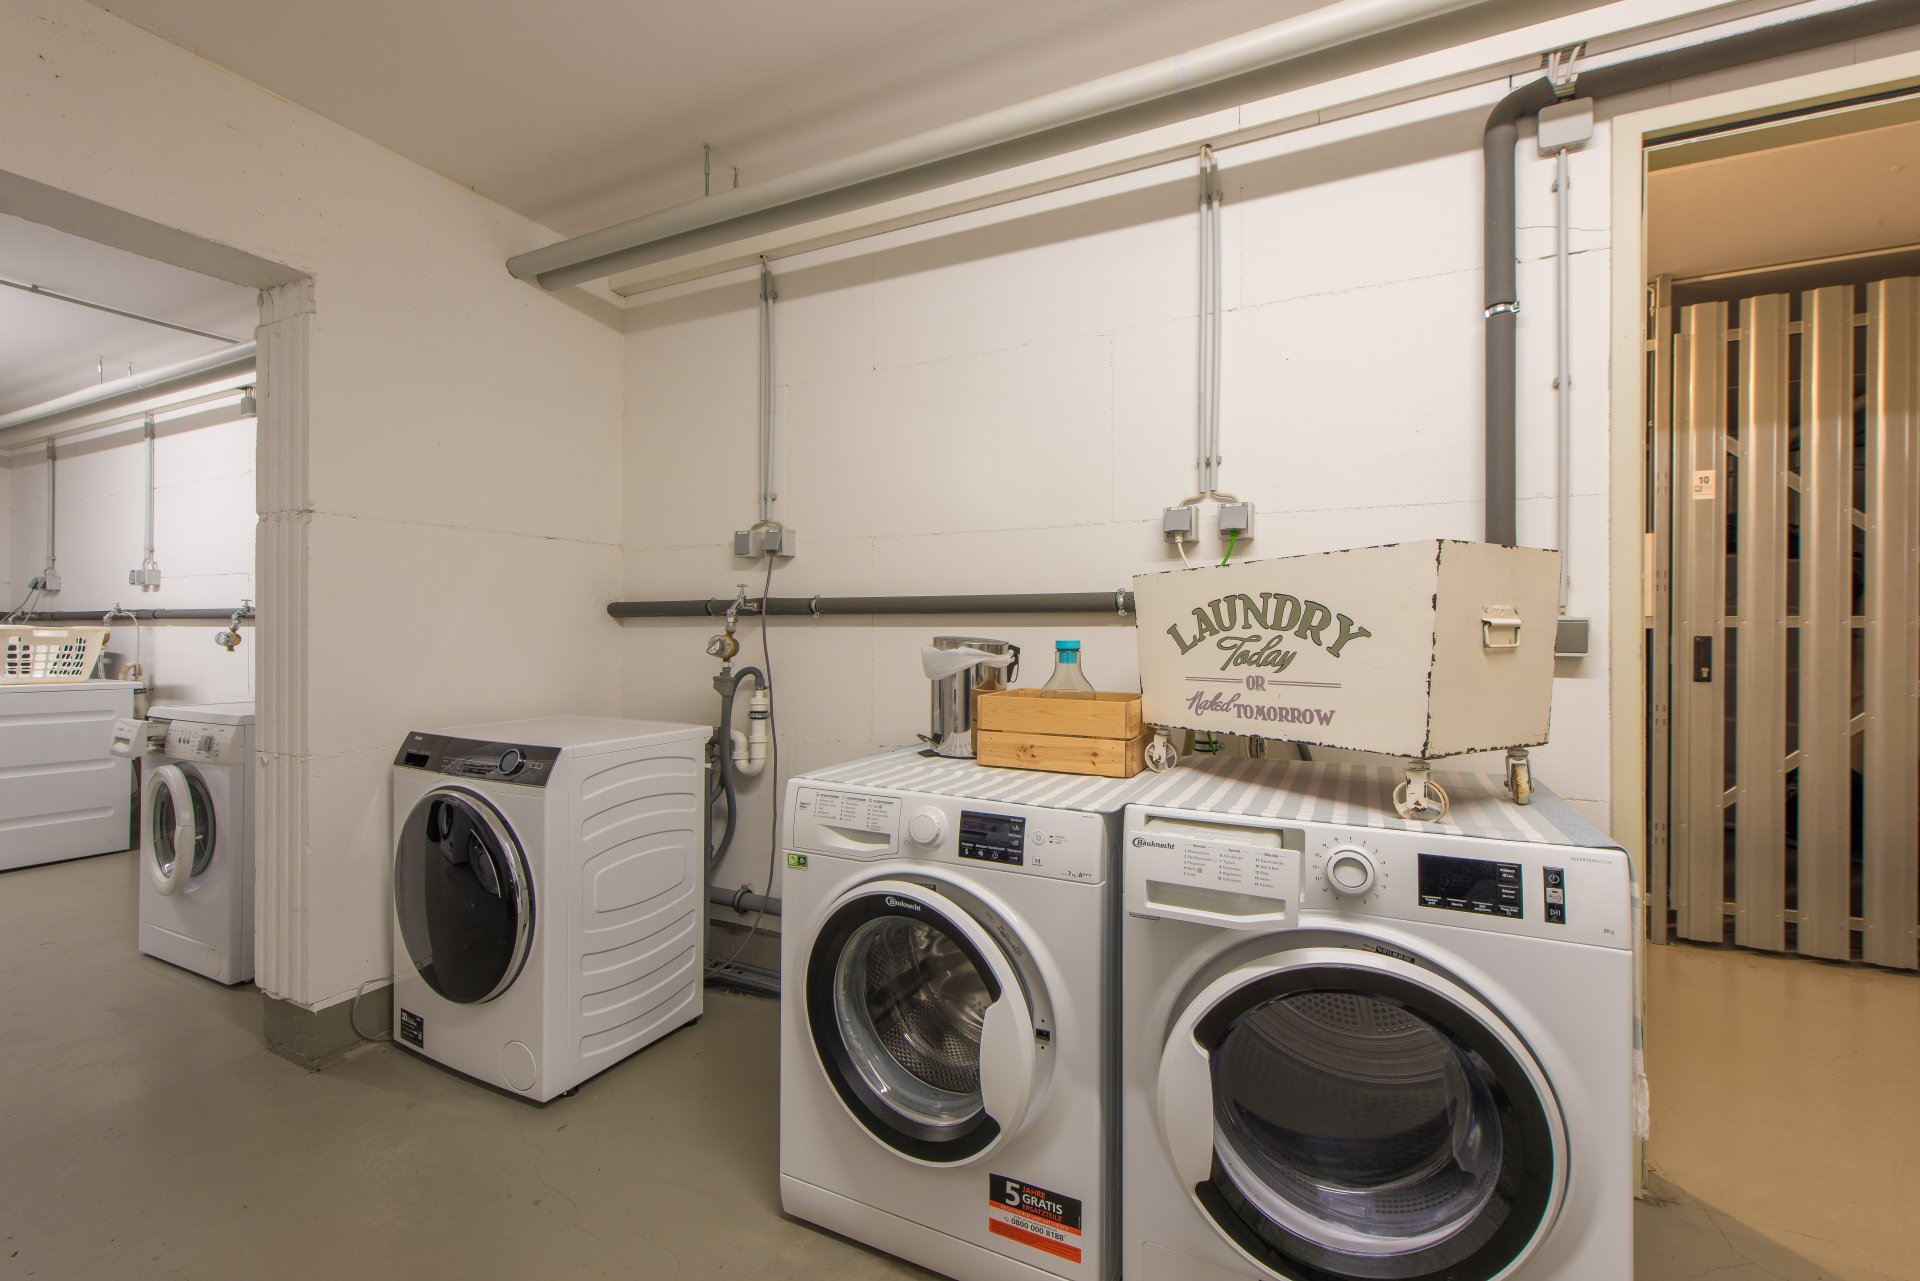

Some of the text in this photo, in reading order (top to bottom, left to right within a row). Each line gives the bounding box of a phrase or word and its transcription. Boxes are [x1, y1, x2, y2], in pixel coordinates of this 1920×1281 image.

[1698, 476, 1710, 484] 10
[1166, 592, 1372, 659] LAUNDRY
[1216, 634, 1298, 674] Today
[1245, 675, 1266, 692] OR
[1185, 690, 1336, 728] Naked TOMORROW
[1132, 837, 1175, 850] Bauknecht
[885, 896, 922, 912] Bauknecht
[1005, 1180, 1020, 1206] 5
[1022, 1186, 1046, 1200] JAHRE
[1022, 1194, 1063, 1215] GRATIS
[1022, 1204, 1063, 1222] ERSATZTEILE
[1011, 1217, 1029, 1230] 0800
[1030, 1224, 1044, 1235] 000
[1045, 1230, 1064, 1242] 8188
